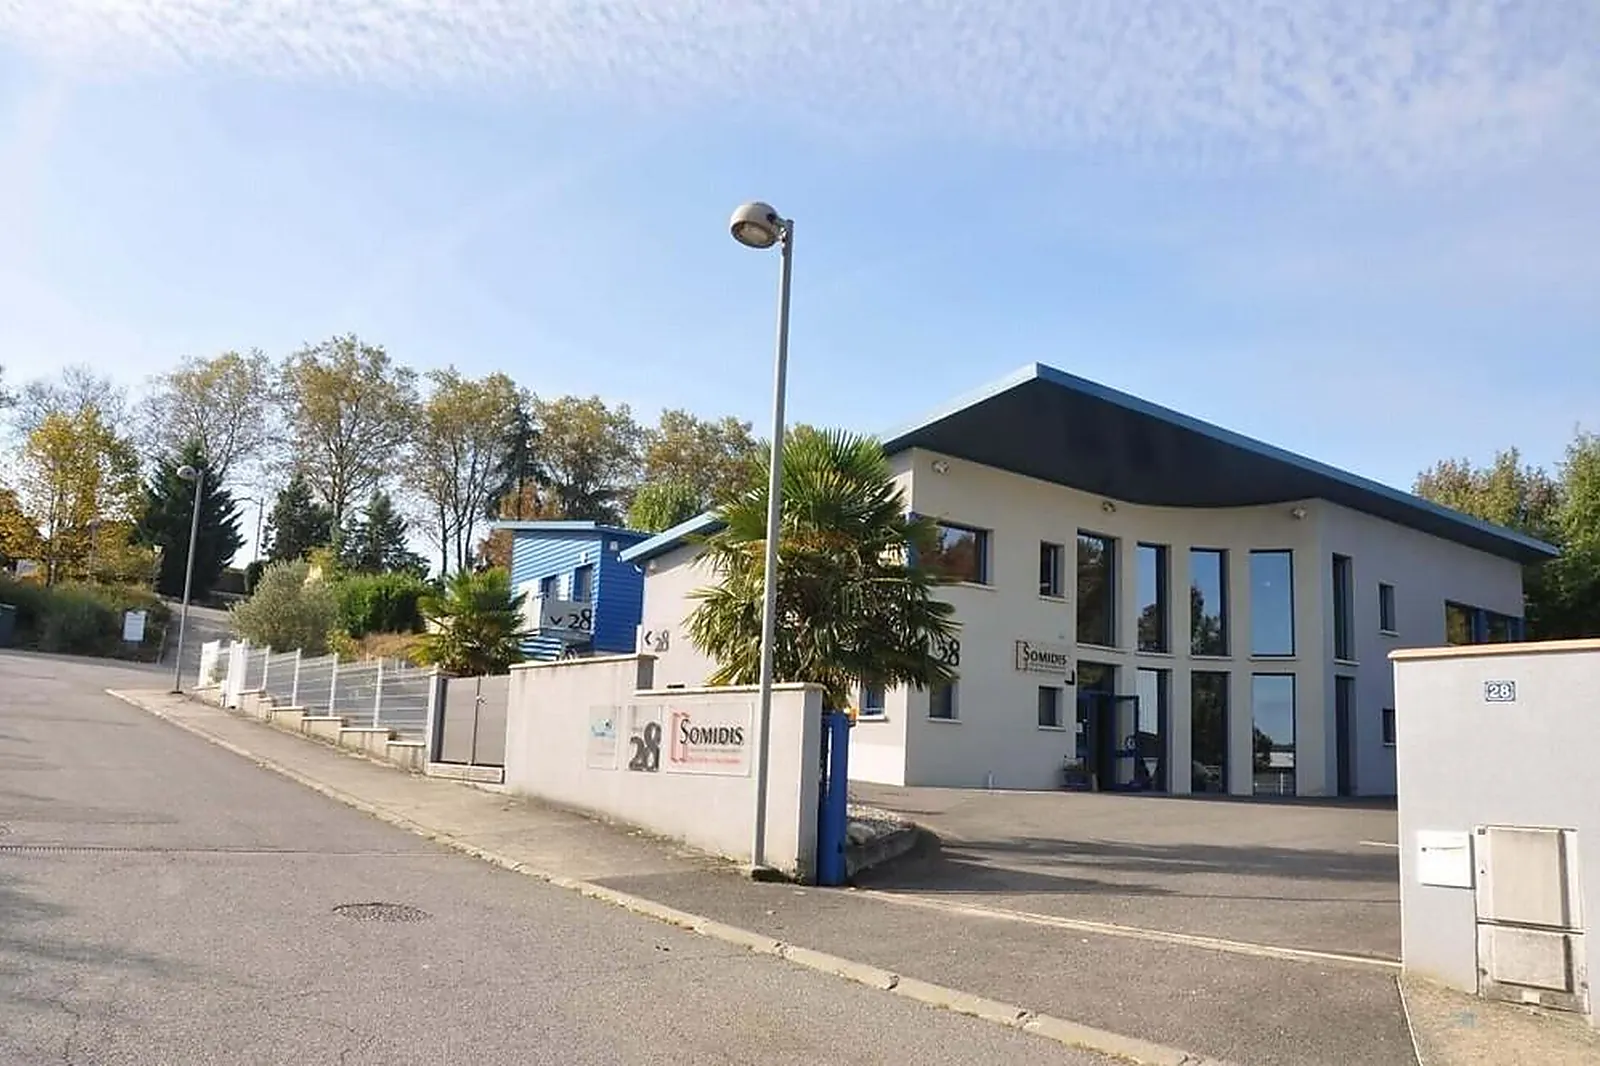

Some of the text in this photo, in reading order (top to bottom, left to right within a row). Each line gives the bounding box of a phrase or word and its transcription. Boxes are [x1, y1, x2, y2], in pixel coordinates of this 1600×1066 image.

[568, 608, 592, 631] 28
[655, 630, 669, 652] 28
[1489, 684, 1511, 698] 28
[680, 718, 745, 746] SOMIDIS
[628, 721, 662, 773] 28
